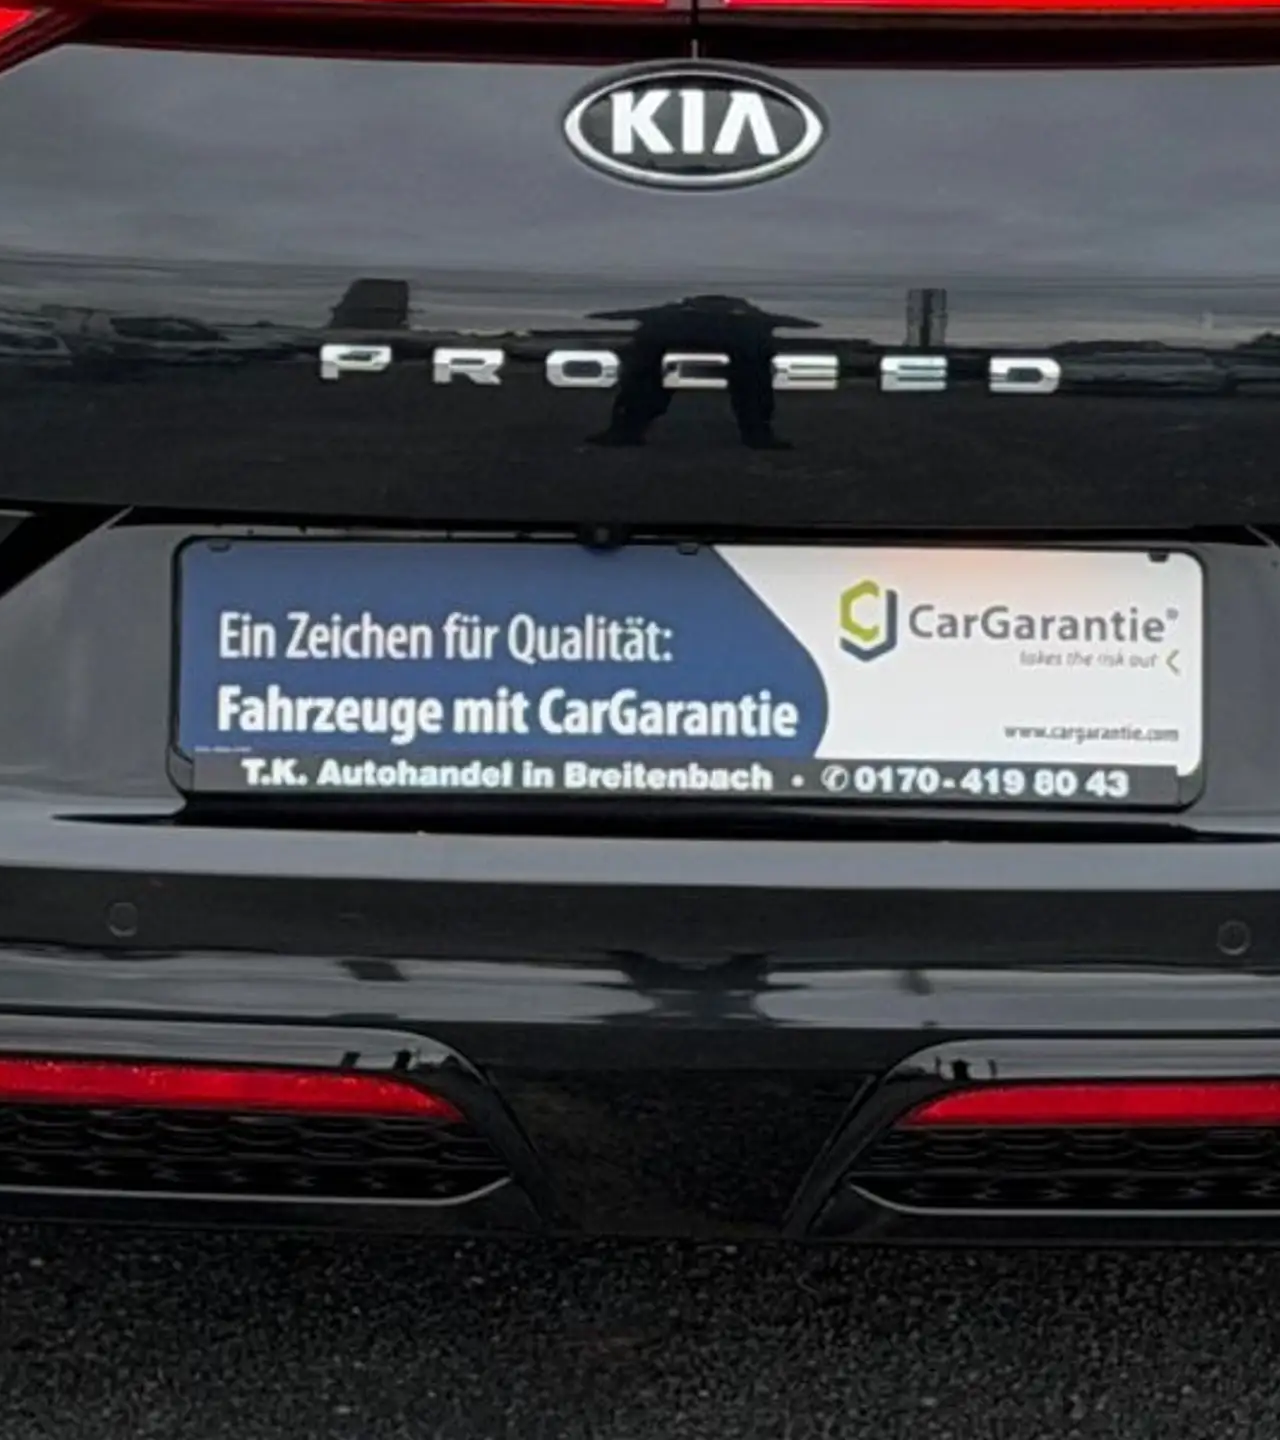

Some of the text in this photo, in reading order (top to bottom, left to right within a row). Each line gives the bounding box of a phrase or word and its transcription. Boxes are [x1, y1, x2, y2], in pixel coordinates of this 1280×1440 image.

[610, 89, 781, 156] KIA
[320, 343, 1062, 394] PROCEED
[219, 611, 674, 665] Ein Zeichen für Qualität:
[1066, 649, 1092, 667] the
[217, 683, 800, 746] Fahrzeuge mit CarGarantie
[1003, 723, 1181, 745] www.cargarantie.com
[240, 758, 310, 788] T.K.
[316, 759, 515, 789] Autohandel
[521, 761, 556, 790] in
[563, 761, 774, 791] Breitenbach
[1033, 768, 1078, 797] 80
[1085, 769, 1131, 799] 43
